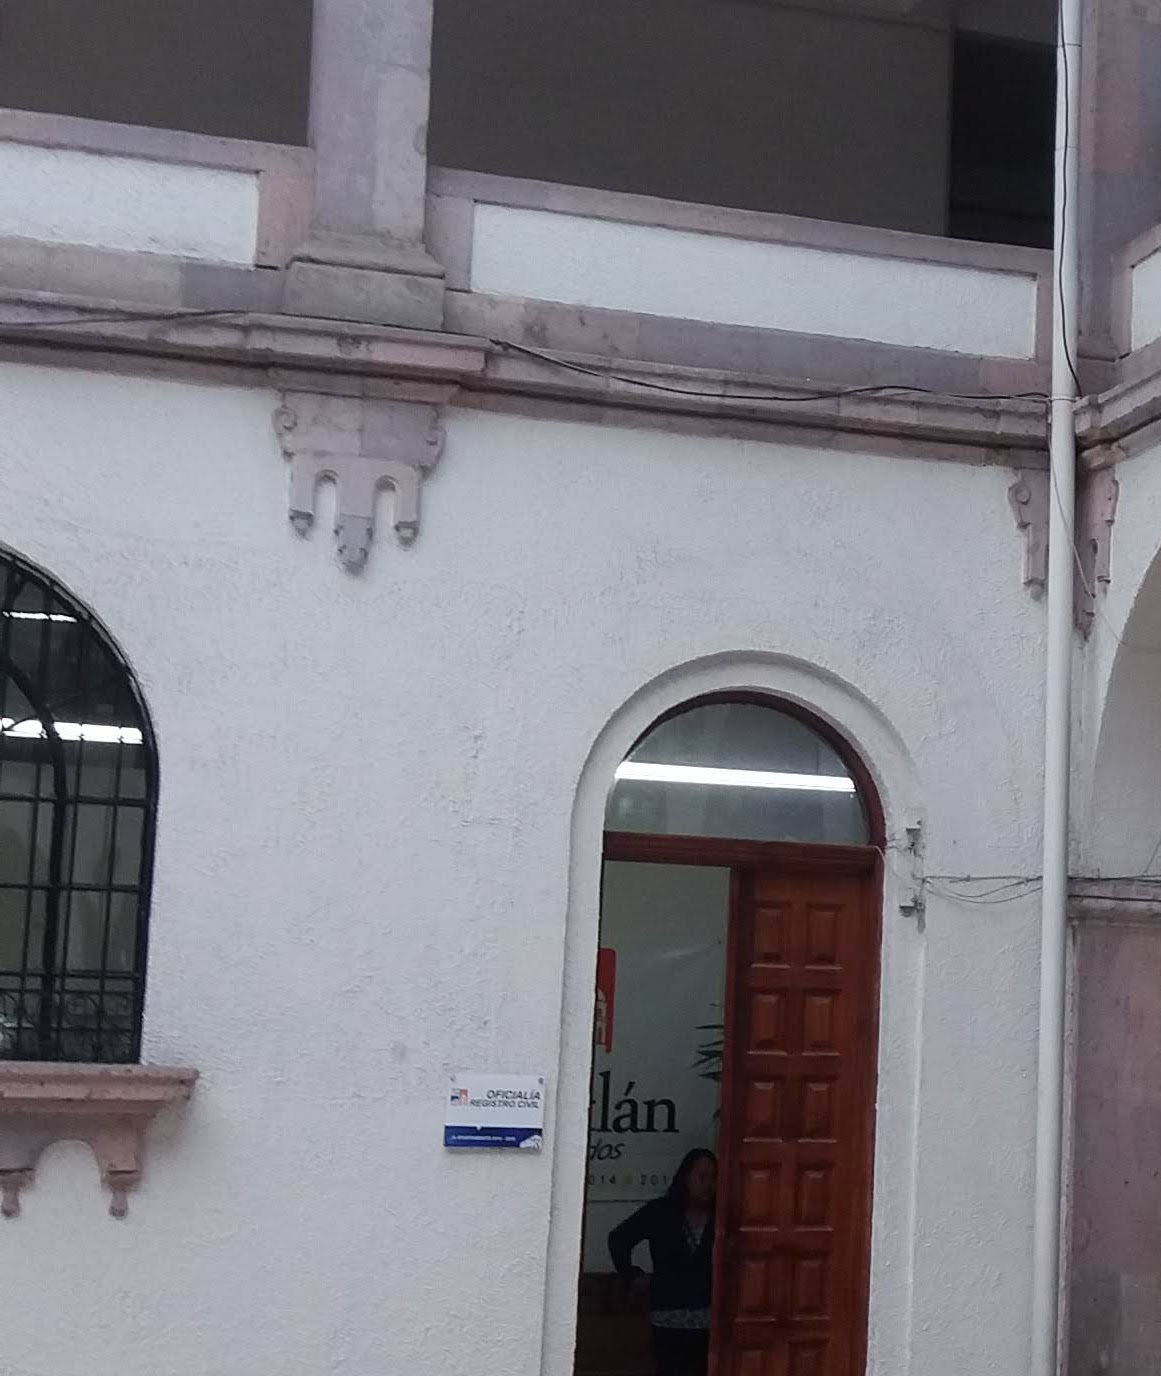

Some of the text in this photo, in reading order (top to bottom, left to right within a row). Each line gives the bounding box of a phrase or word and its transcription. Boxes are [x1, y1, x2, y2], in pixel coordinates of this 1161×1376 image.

[470, 1099, 539, 1109] REGISTRO CIVIL
[590, 1070, 680, 1134] lán
